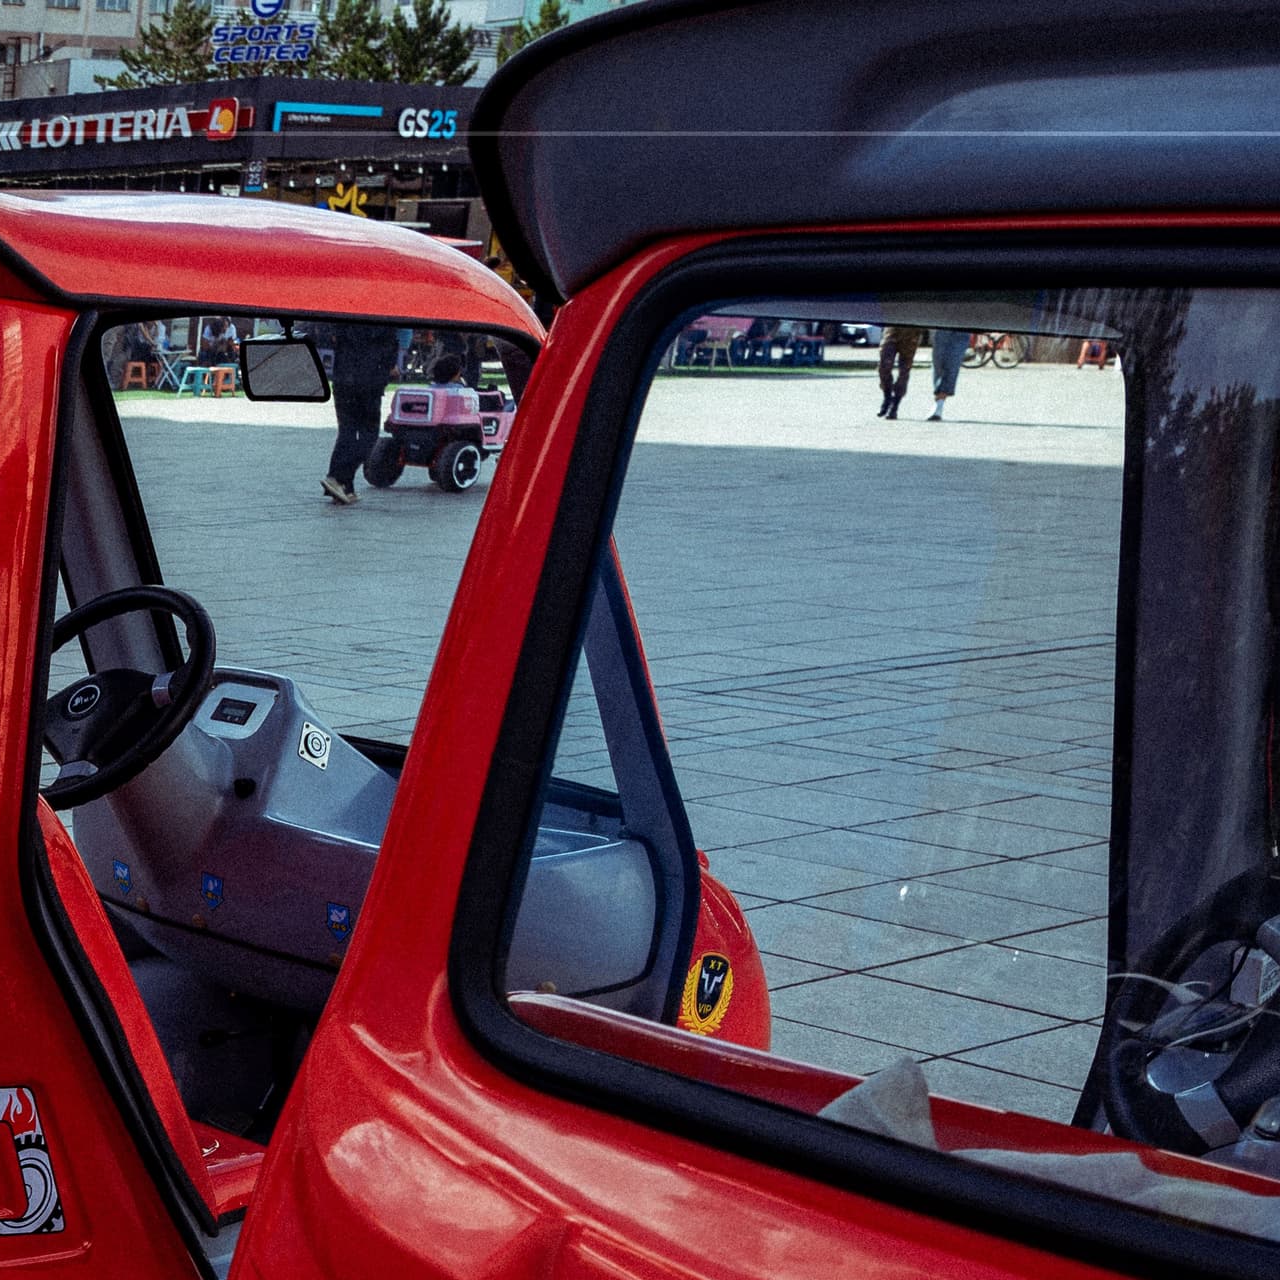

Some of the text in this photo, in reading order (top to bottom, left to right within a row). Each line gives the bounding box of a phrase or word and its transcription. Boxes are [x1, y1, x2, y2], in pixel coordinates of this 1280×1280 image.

[213, 23, 316, 42] SPORTS
[214, 43, 310, 62] CENTER
[29, 106, 193, 149] LOTTERIA
[398, 107, 459, 139] GS25
